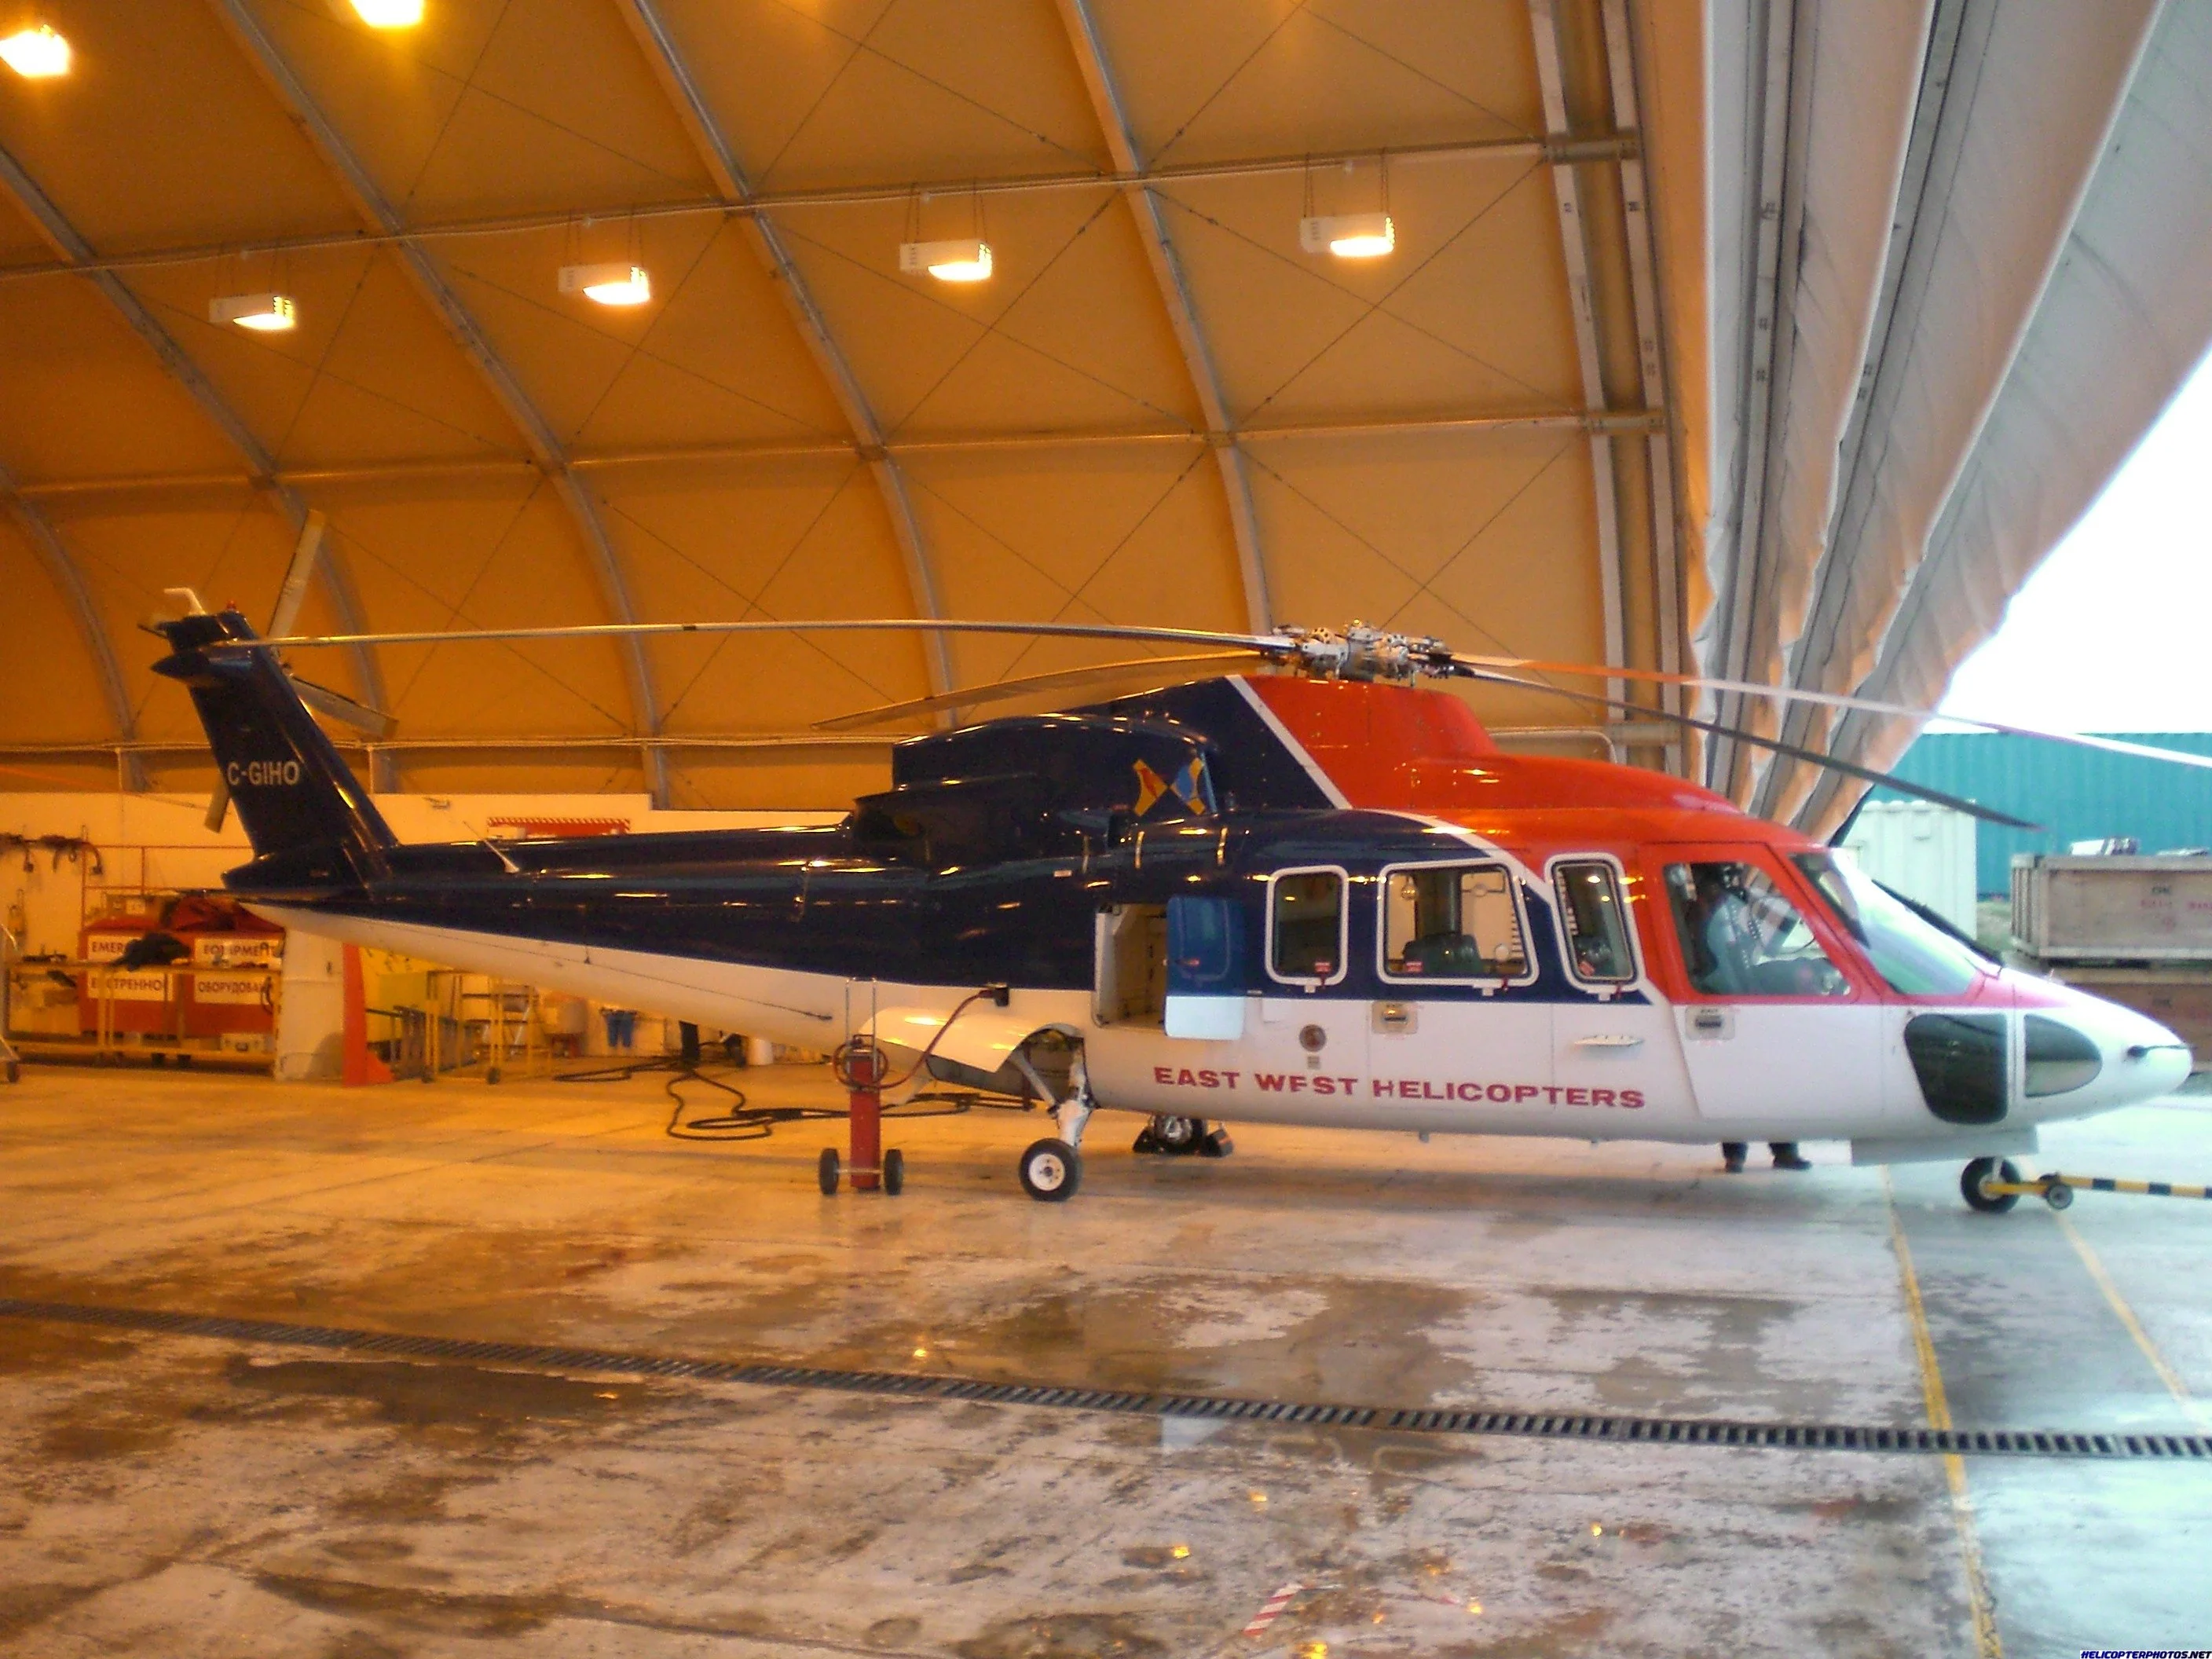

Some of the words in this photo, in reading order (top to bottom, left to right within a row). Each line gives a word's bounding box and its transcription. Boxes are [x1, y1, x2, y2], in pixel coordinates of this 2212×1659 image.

[227, 760, 299, 786] C-GIHO
[92, 941, 124, 953] EMER
[90, 977, 162, 991] ЕСТРЕННО
[198, 980, 262, 994] ОБОРУДОВА
[1154, 1067, 1240, 1090] EAST
[1254, 1073, 1358, 1095] WEST
[1372, 1079, 1646, 1108] HELICOPTERS
